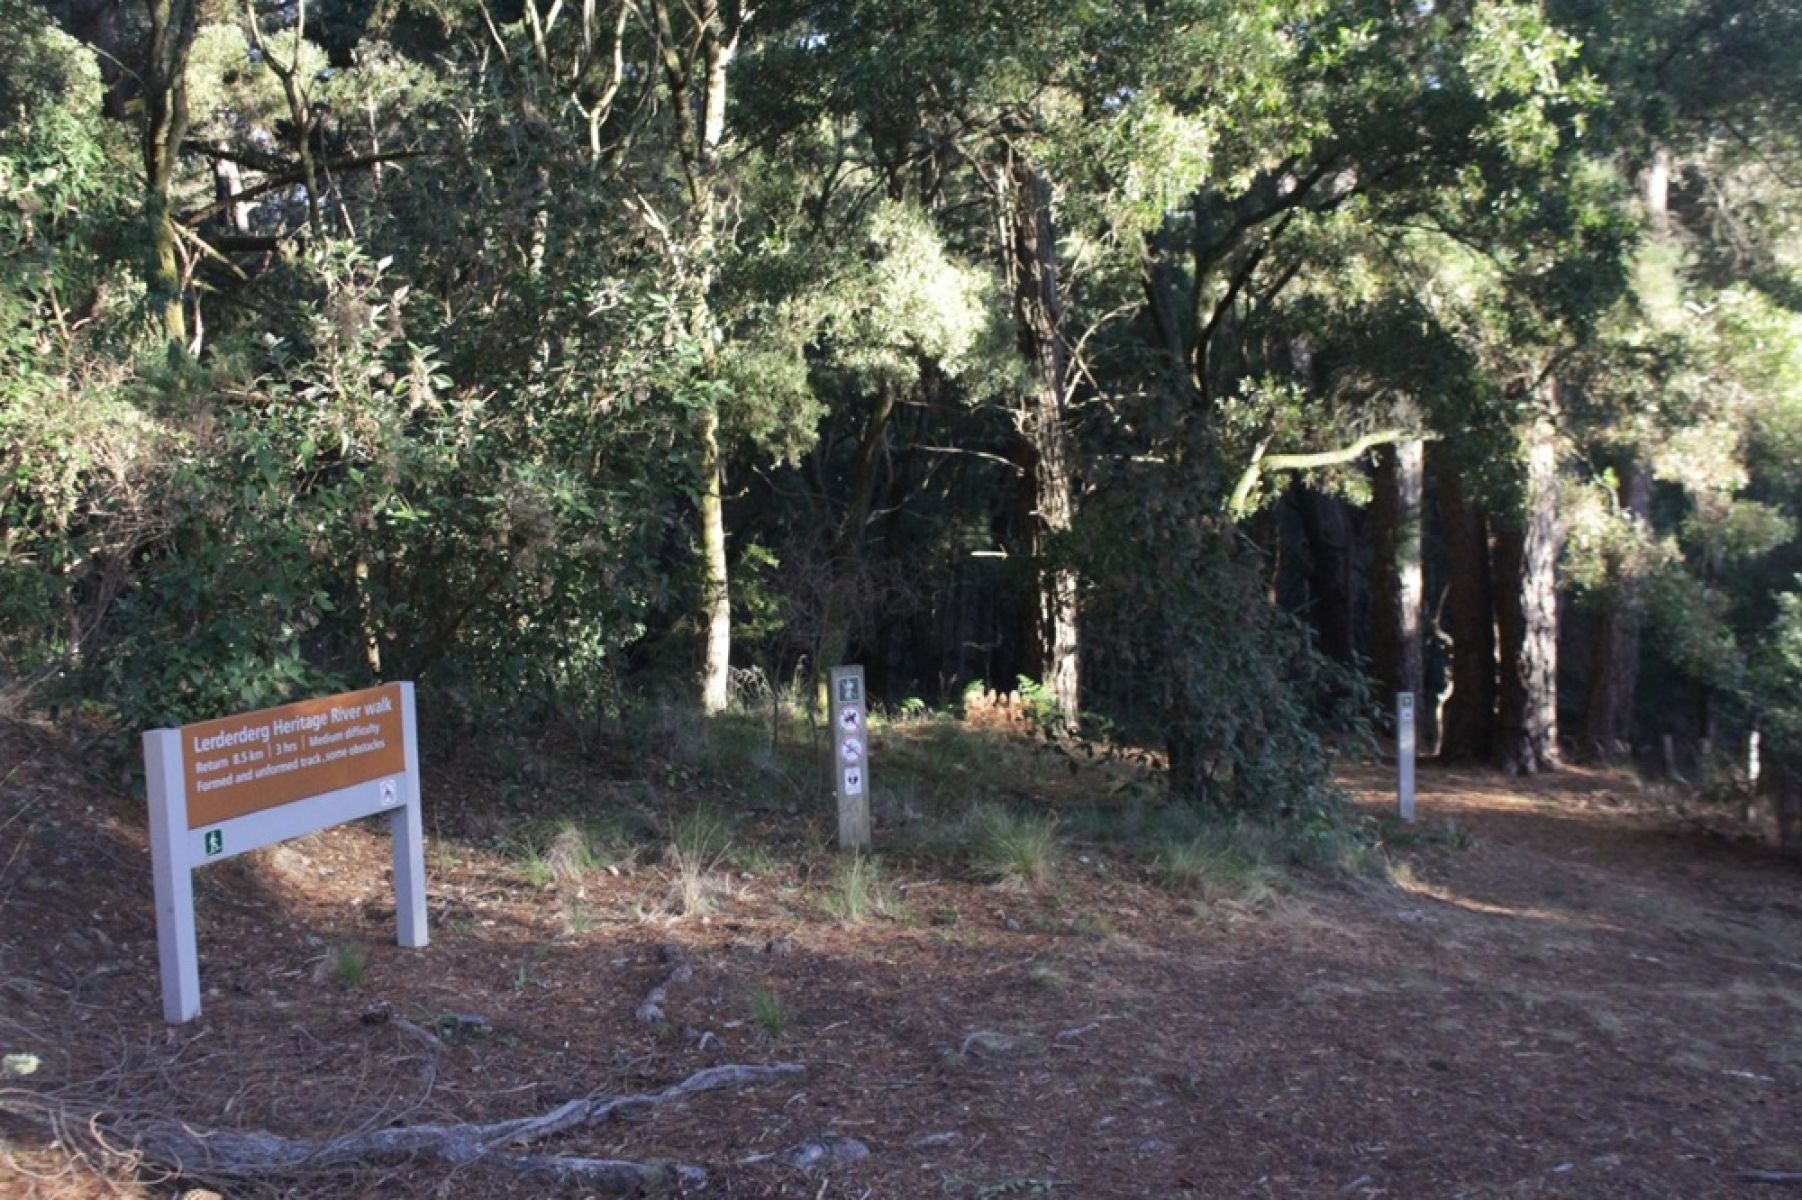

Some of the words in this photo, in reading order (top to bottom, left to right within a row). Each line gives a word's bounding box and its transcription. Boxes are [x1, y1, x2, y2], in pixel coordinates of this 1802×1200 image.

[194, 725, 270, 753] Lerderderg
[273, 712, 328, 735] Heritage
[330, 704, 361, 724] River
[364, 697, 392, 715] walk
[195, 758, 228, 774] Return
[249, 749, 265, 763] km
[275, 743, 282, 755] 3
[309, 732, 343, 746] Medium
[345, 723, 380, 740] difficulty
[197, 775, 233, 792] Formed
[235, 767, 253, 783] and
[255, 759, 299, 778] unformed
[349, 740, 385, 755] obstacles
